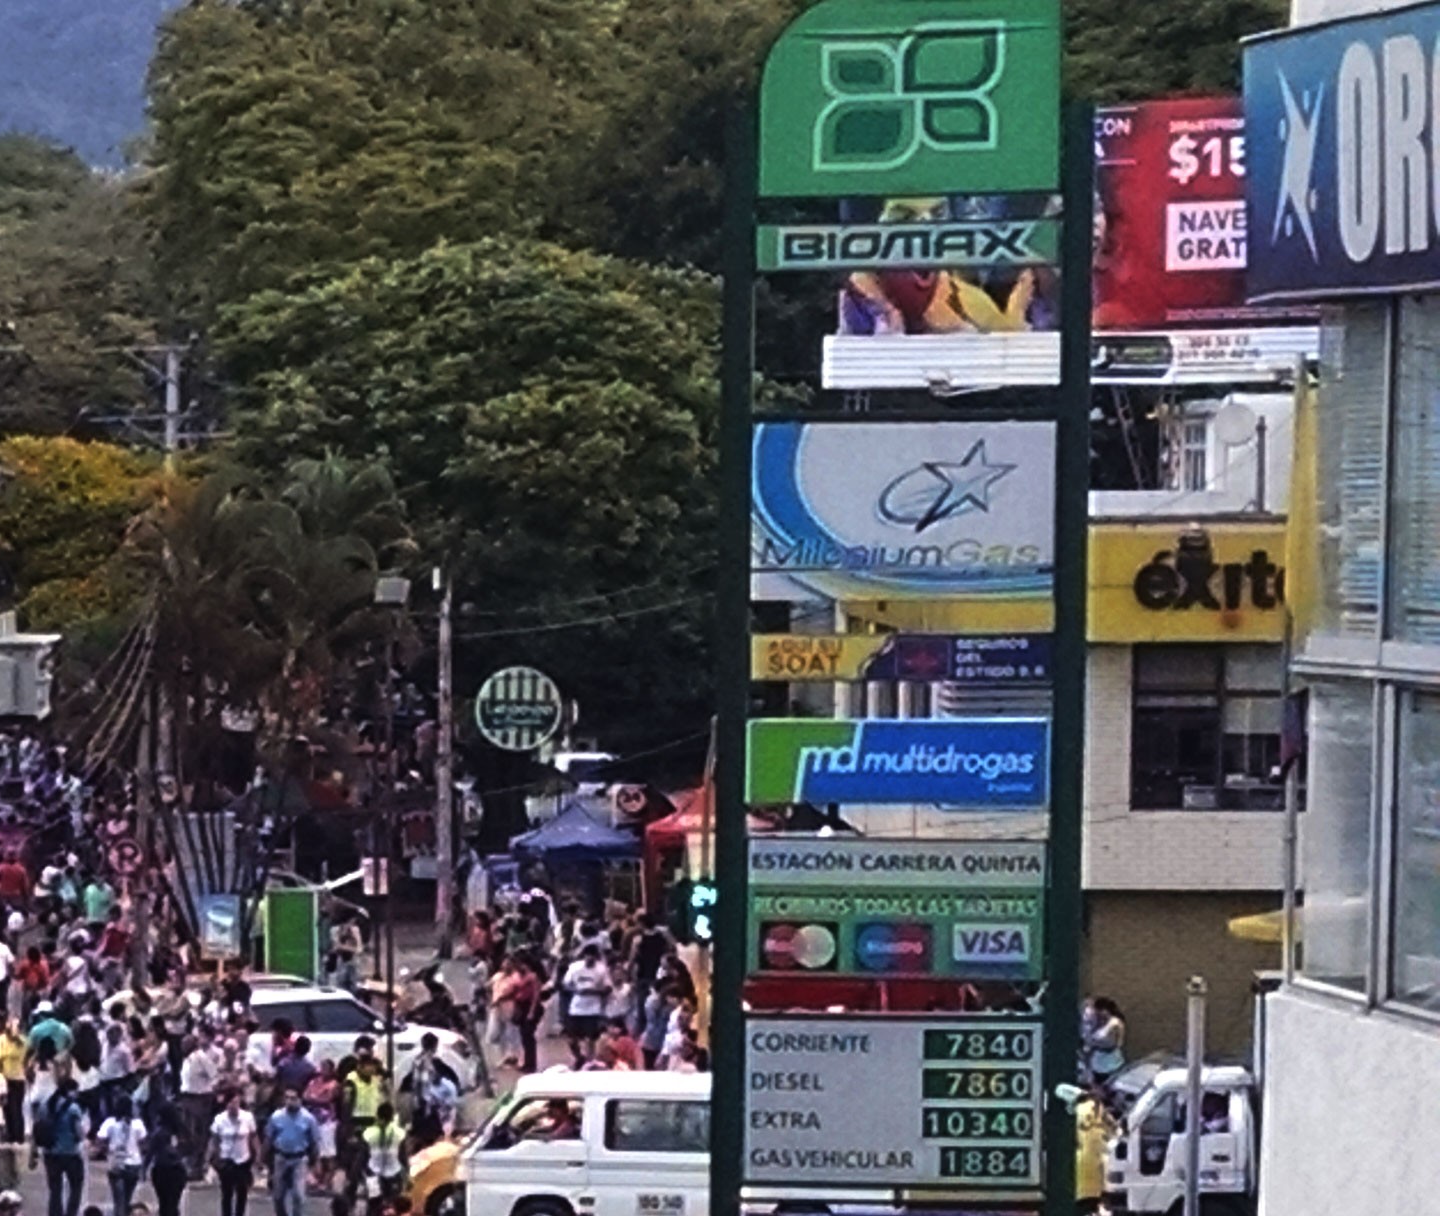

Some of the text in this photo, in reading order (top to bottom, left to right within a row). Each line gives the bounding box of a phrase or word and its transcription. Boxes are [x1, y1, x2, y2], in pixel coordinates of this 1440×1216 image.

[1337, 33, 1440, 262] OR
[784, 229, 1028, 261] BIOMAX
[1133, 549, 1286, 629] éxit
[768, 653, 841, 674] SOAT
[863, 745, 1034, 780] multidrogas
[752, 851, 1041, 874] ESTACIÓN CARRERA QUINTA
[754, 896, 852, 915] RECMOS
[959, 930, 1025, 955] VISA
[751, 1033, 1031, 1057] CORRIENTE 7840
[751, 1072, 1031, 1096] DIESEL 7860
[750, 1111, 1032, 1136] EXTRA 10340
[750, 1150, 1028, 1174] GAS VEHICULAR 1884
